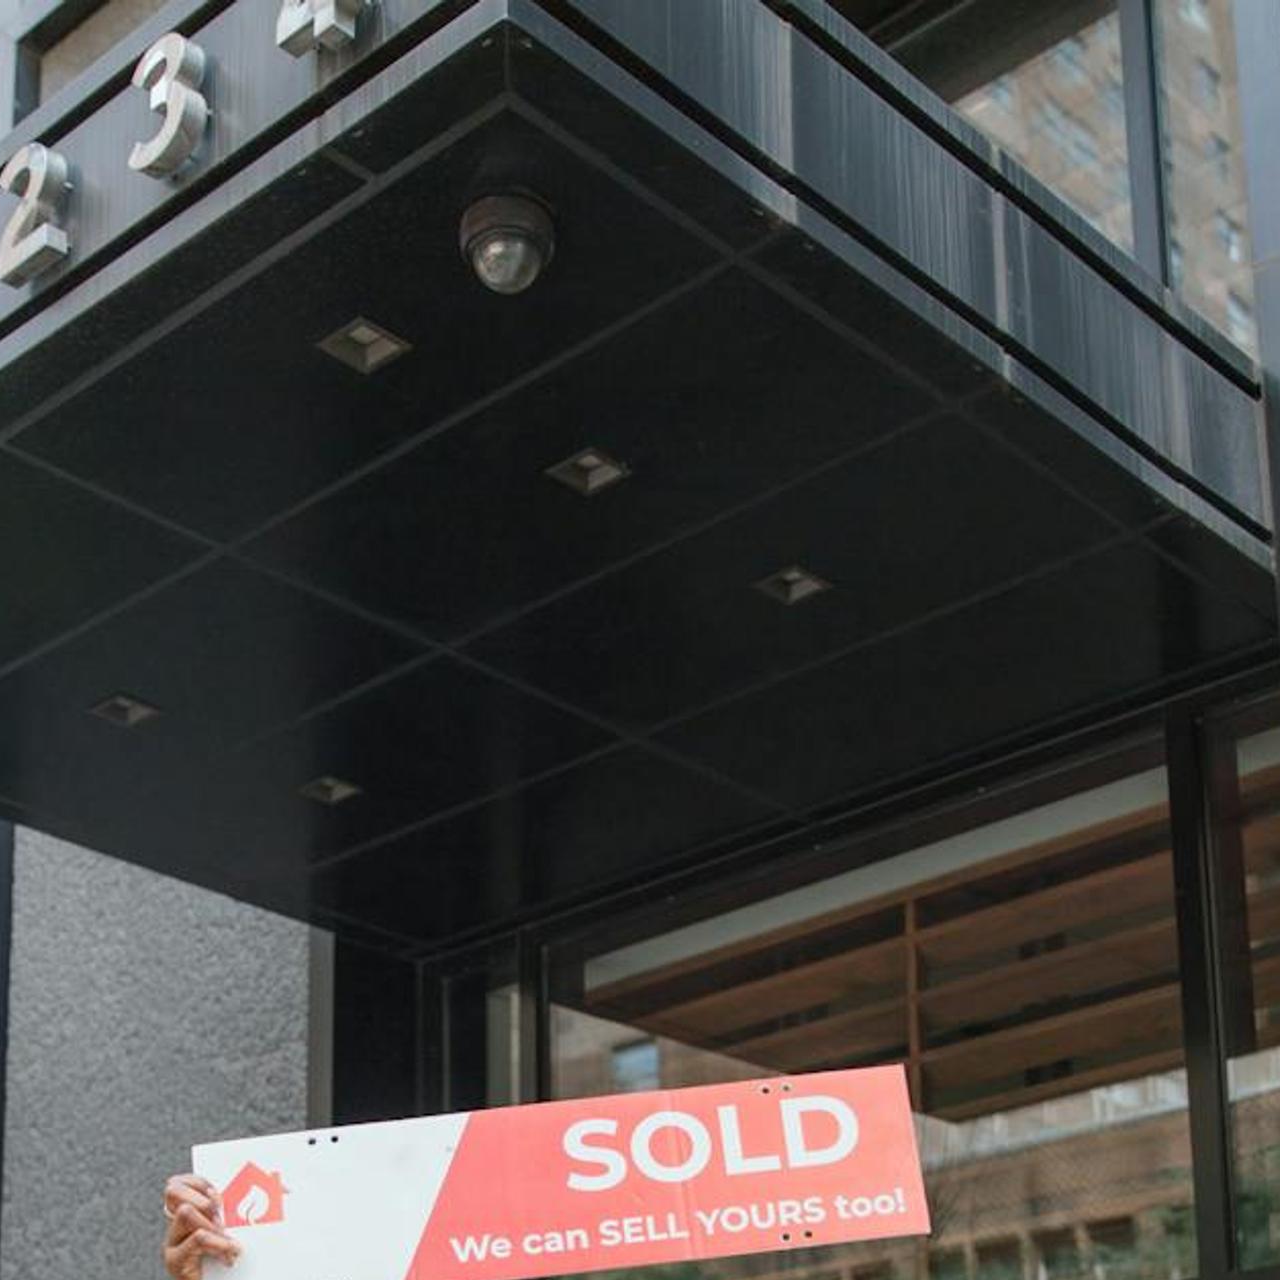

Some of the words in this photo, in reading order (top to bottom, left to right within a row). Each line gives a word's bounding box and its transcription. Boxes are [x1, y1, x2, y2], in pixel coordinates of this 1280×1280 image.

[562, 1095, 859, 1191] SOLD
[450, 1231, 511, 1264] We
[522, 1227, 589, 1254] can
[599, 1214, 690, 1247] SELL
[698, 1200, 826, 1236] YOURS
[834, 1189, 907, 1221] too!
